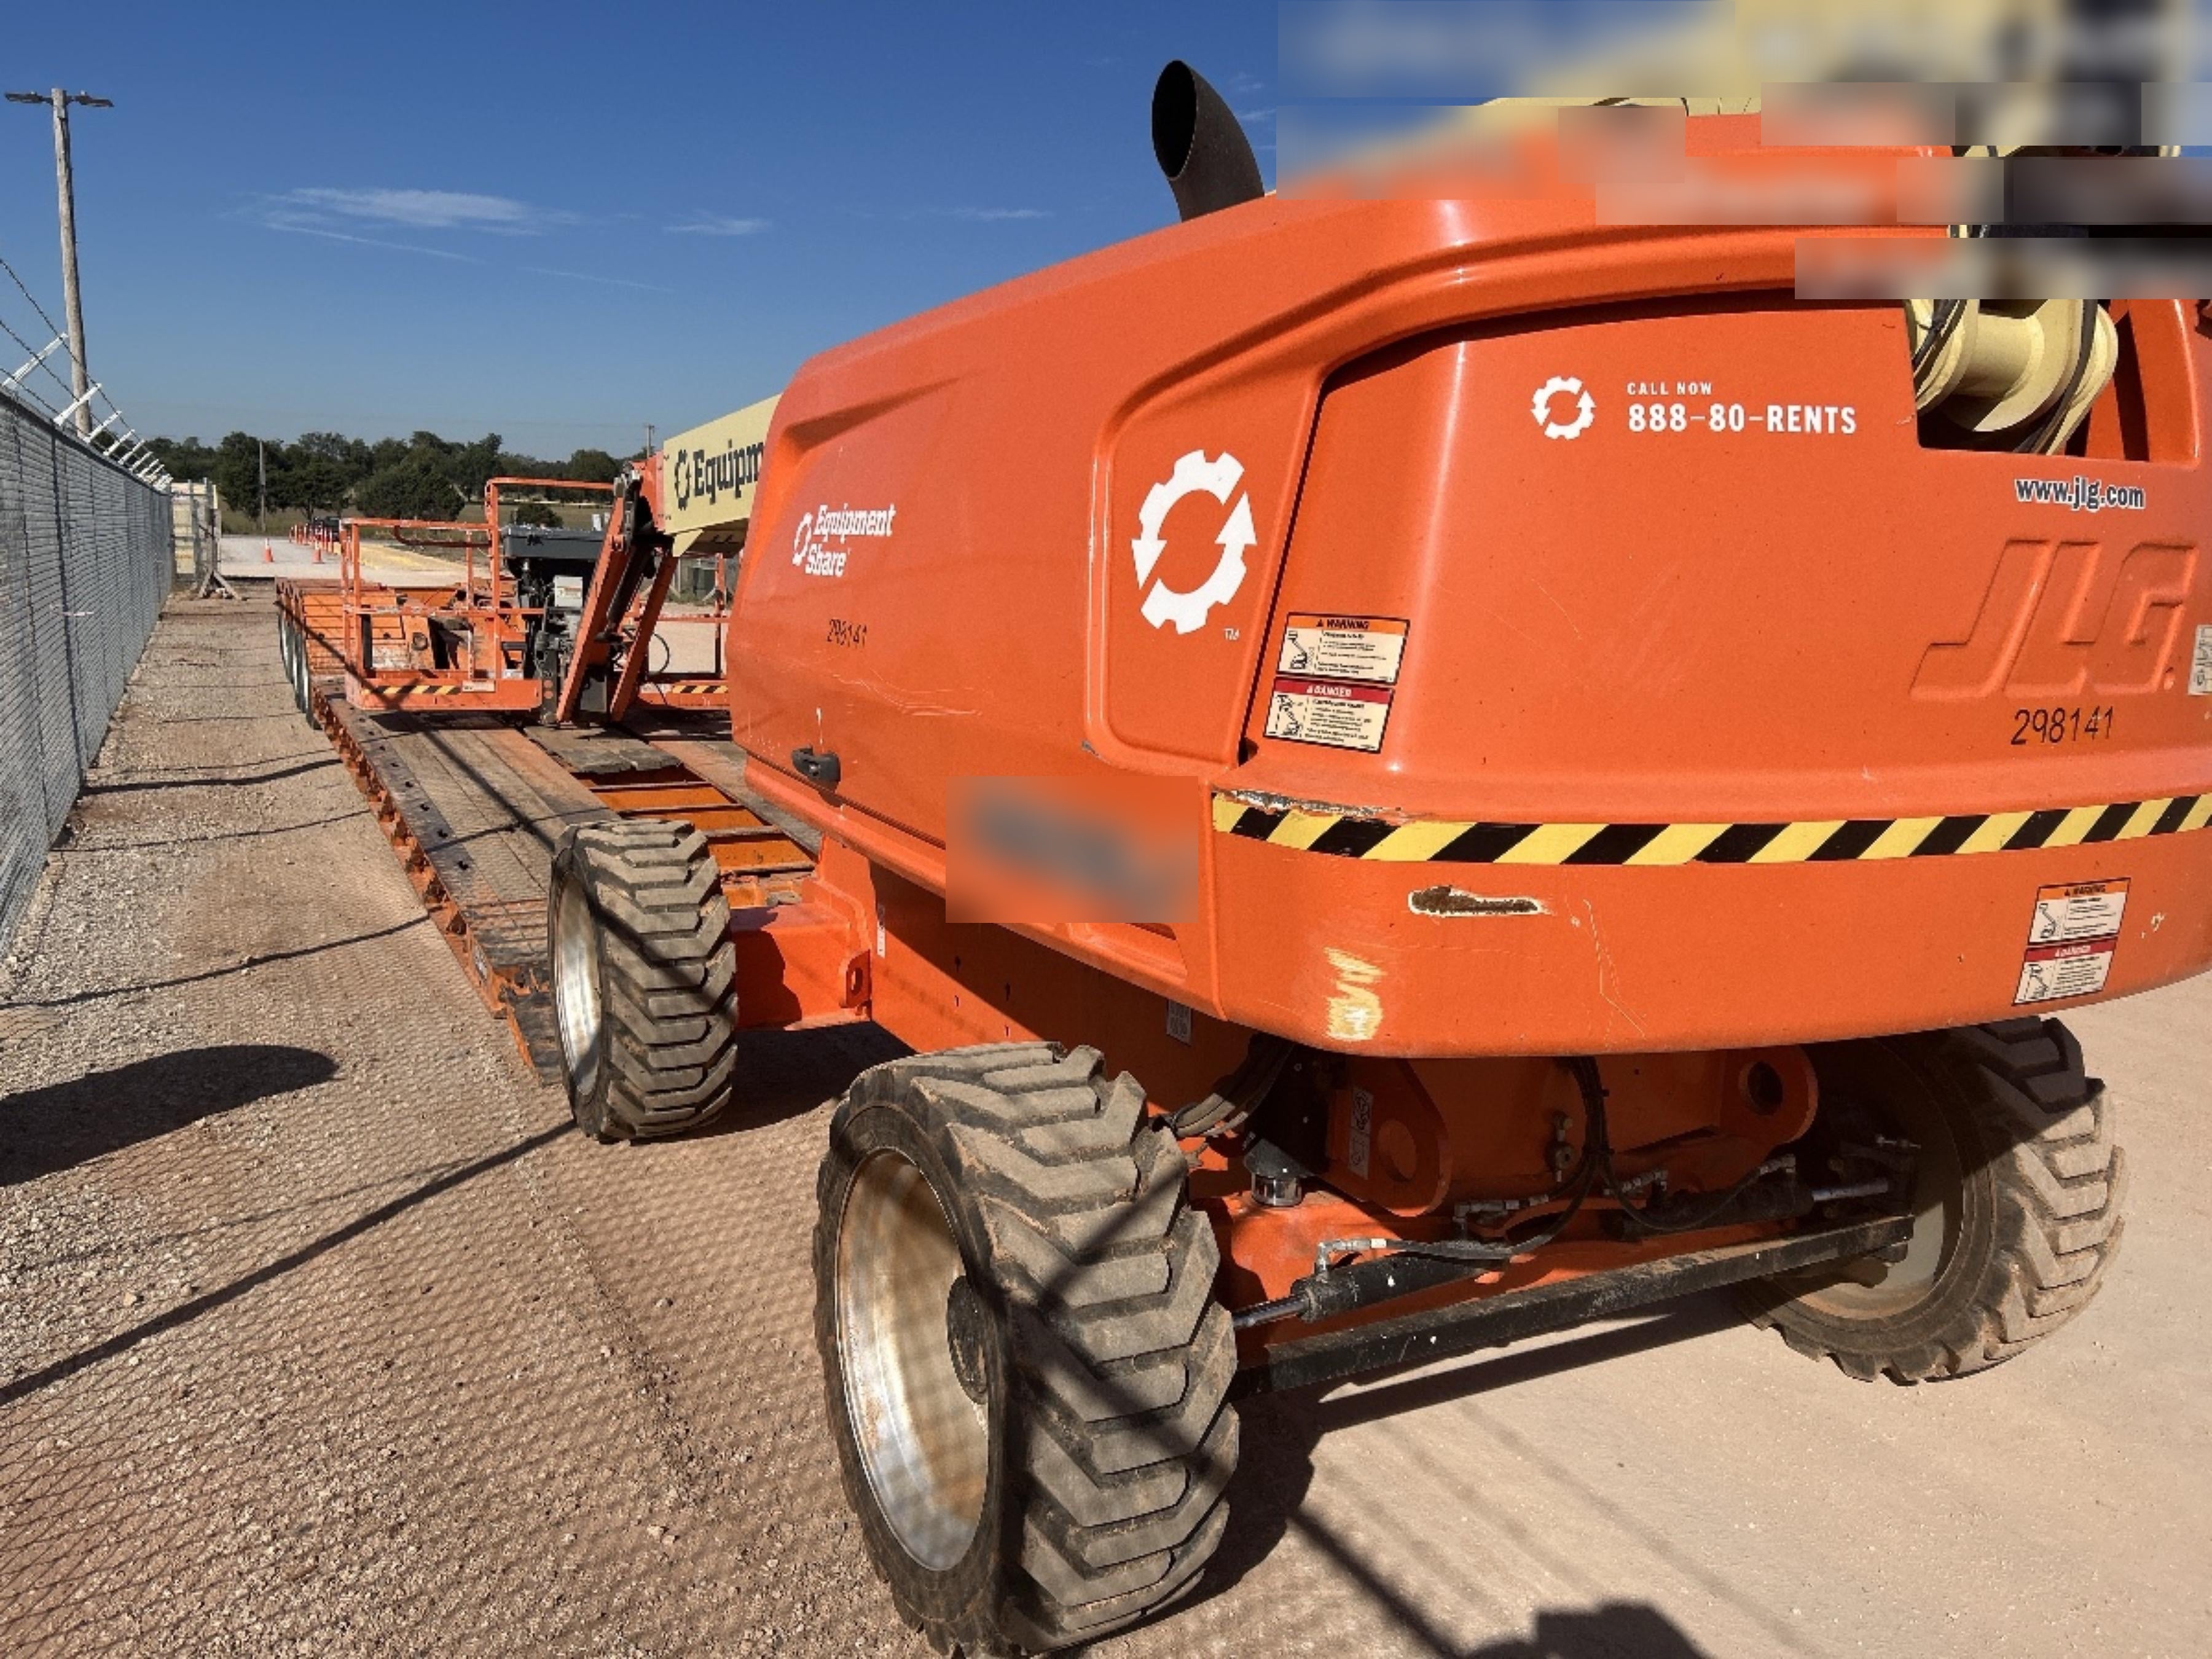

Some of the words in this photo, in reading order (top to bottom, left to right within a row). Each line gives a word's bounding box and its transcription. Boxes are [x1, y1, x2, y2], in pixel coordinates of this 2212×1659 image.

[1627, 382, 1669, 395] CALL
[1677, 382, 1712, 395] NOW
[1628, 403, 1856, 434] 888-80-RENTS
[2015, 477, 2145, 511] www.jlg.com
[813, 503, 896, 544] Equipment
[805, 543, 847, 577] Share
[2010, 706, 2114, 745] 298141
